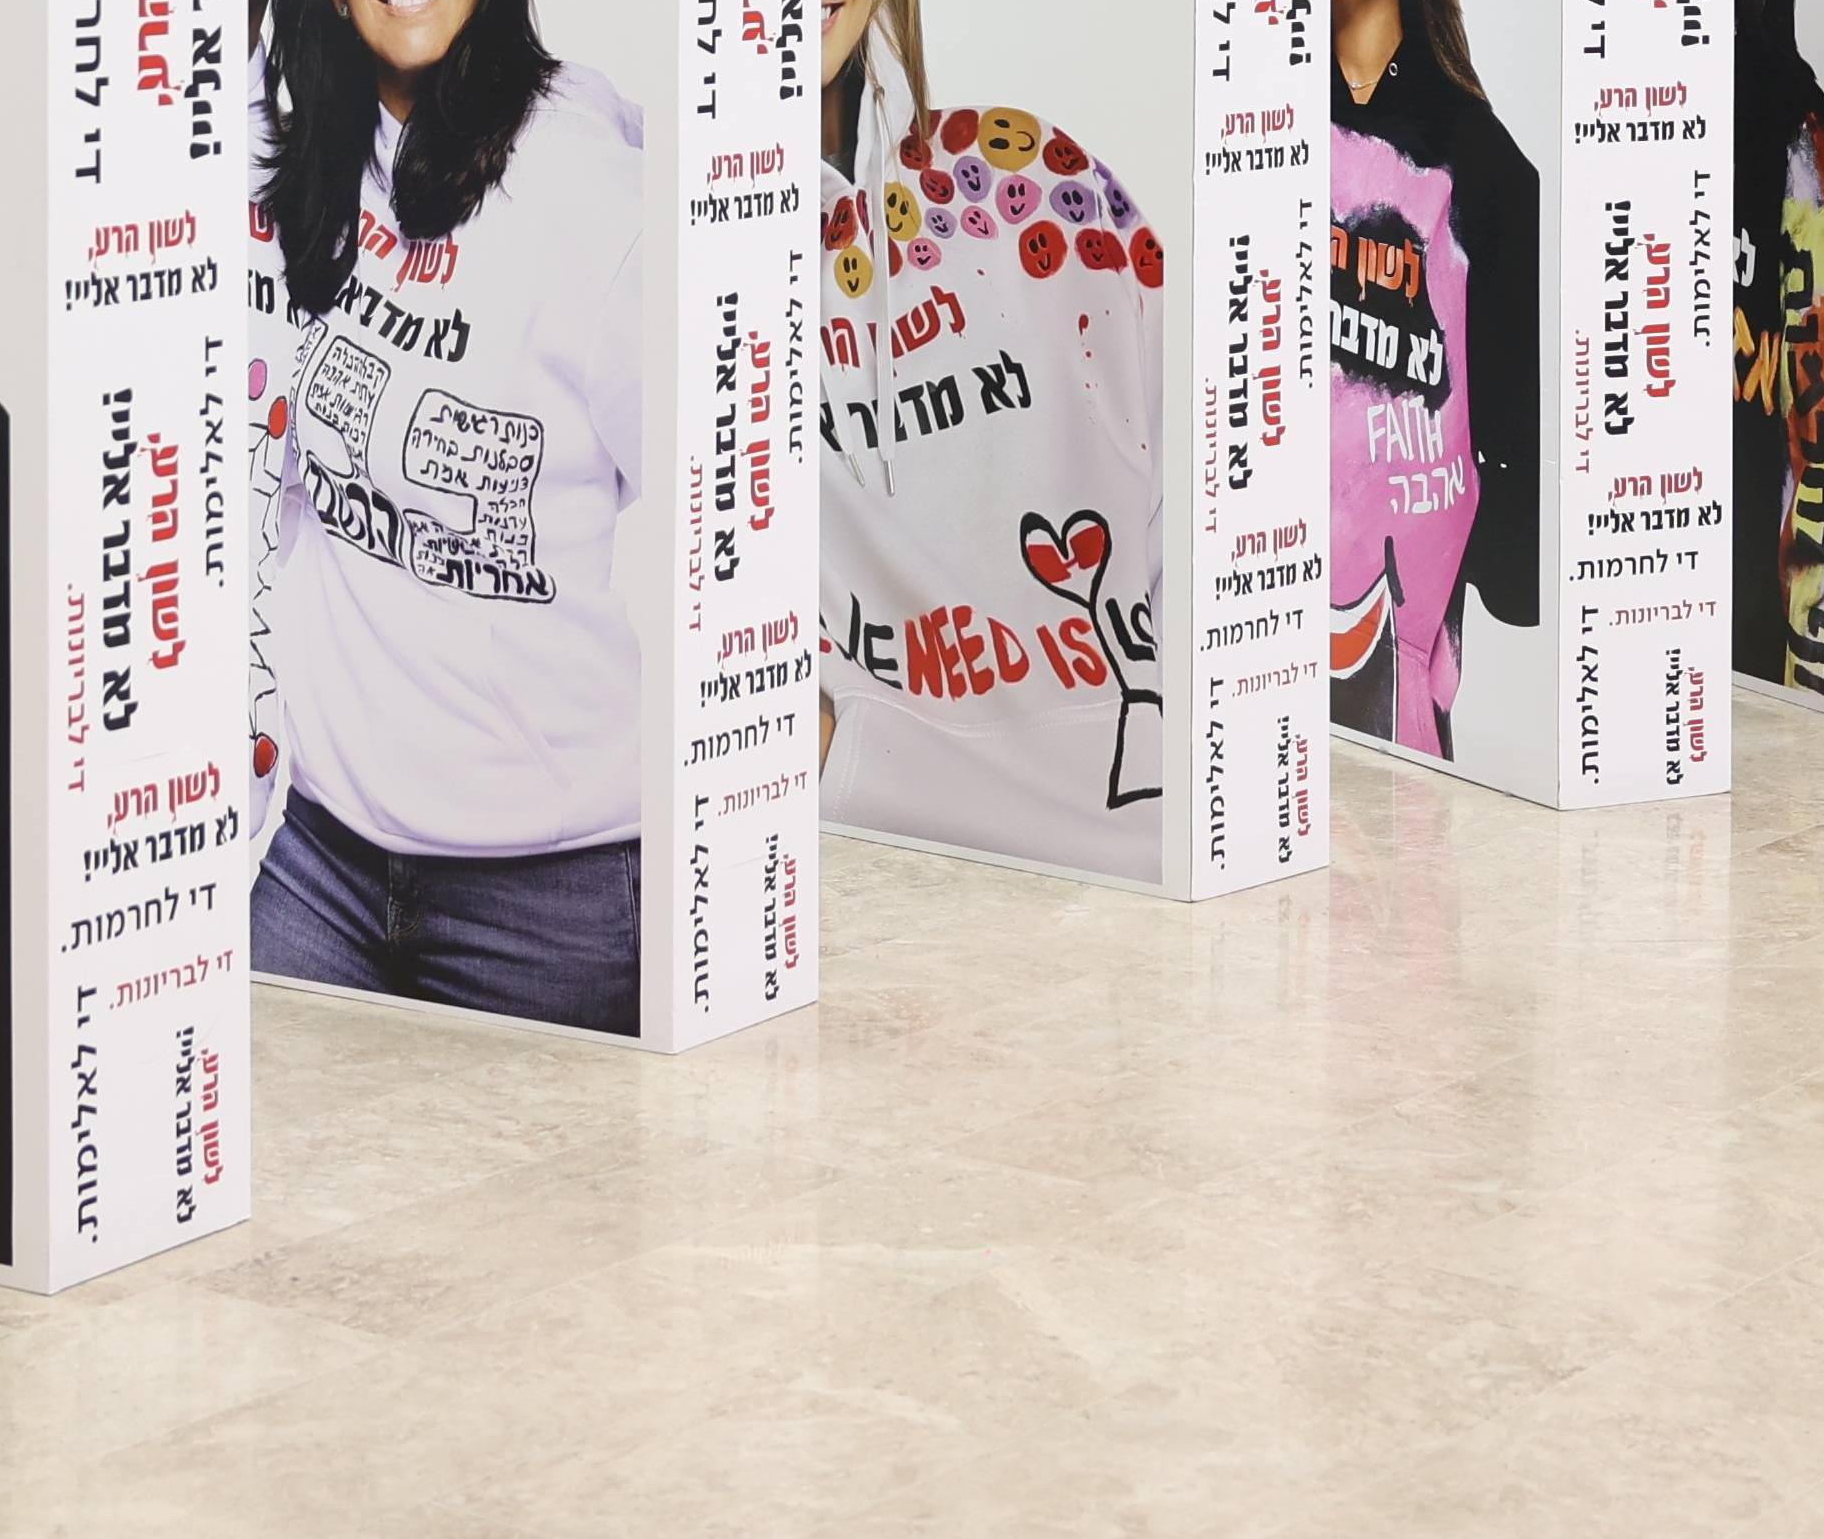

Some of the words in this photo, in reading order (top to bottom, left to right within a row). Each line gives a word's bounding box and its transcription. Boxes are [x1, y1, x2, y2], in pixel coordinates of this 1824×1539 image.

[1358, 236, 1420, 307] לשון
[1406, 329, 1443, 386] לא
[1367, 395, 1444, 463] FAITH
[1389, 455, 1465, 514] אהבה
[904, 605, 1030, 701] NEED
[1036, 617, 1107, 690] IS
